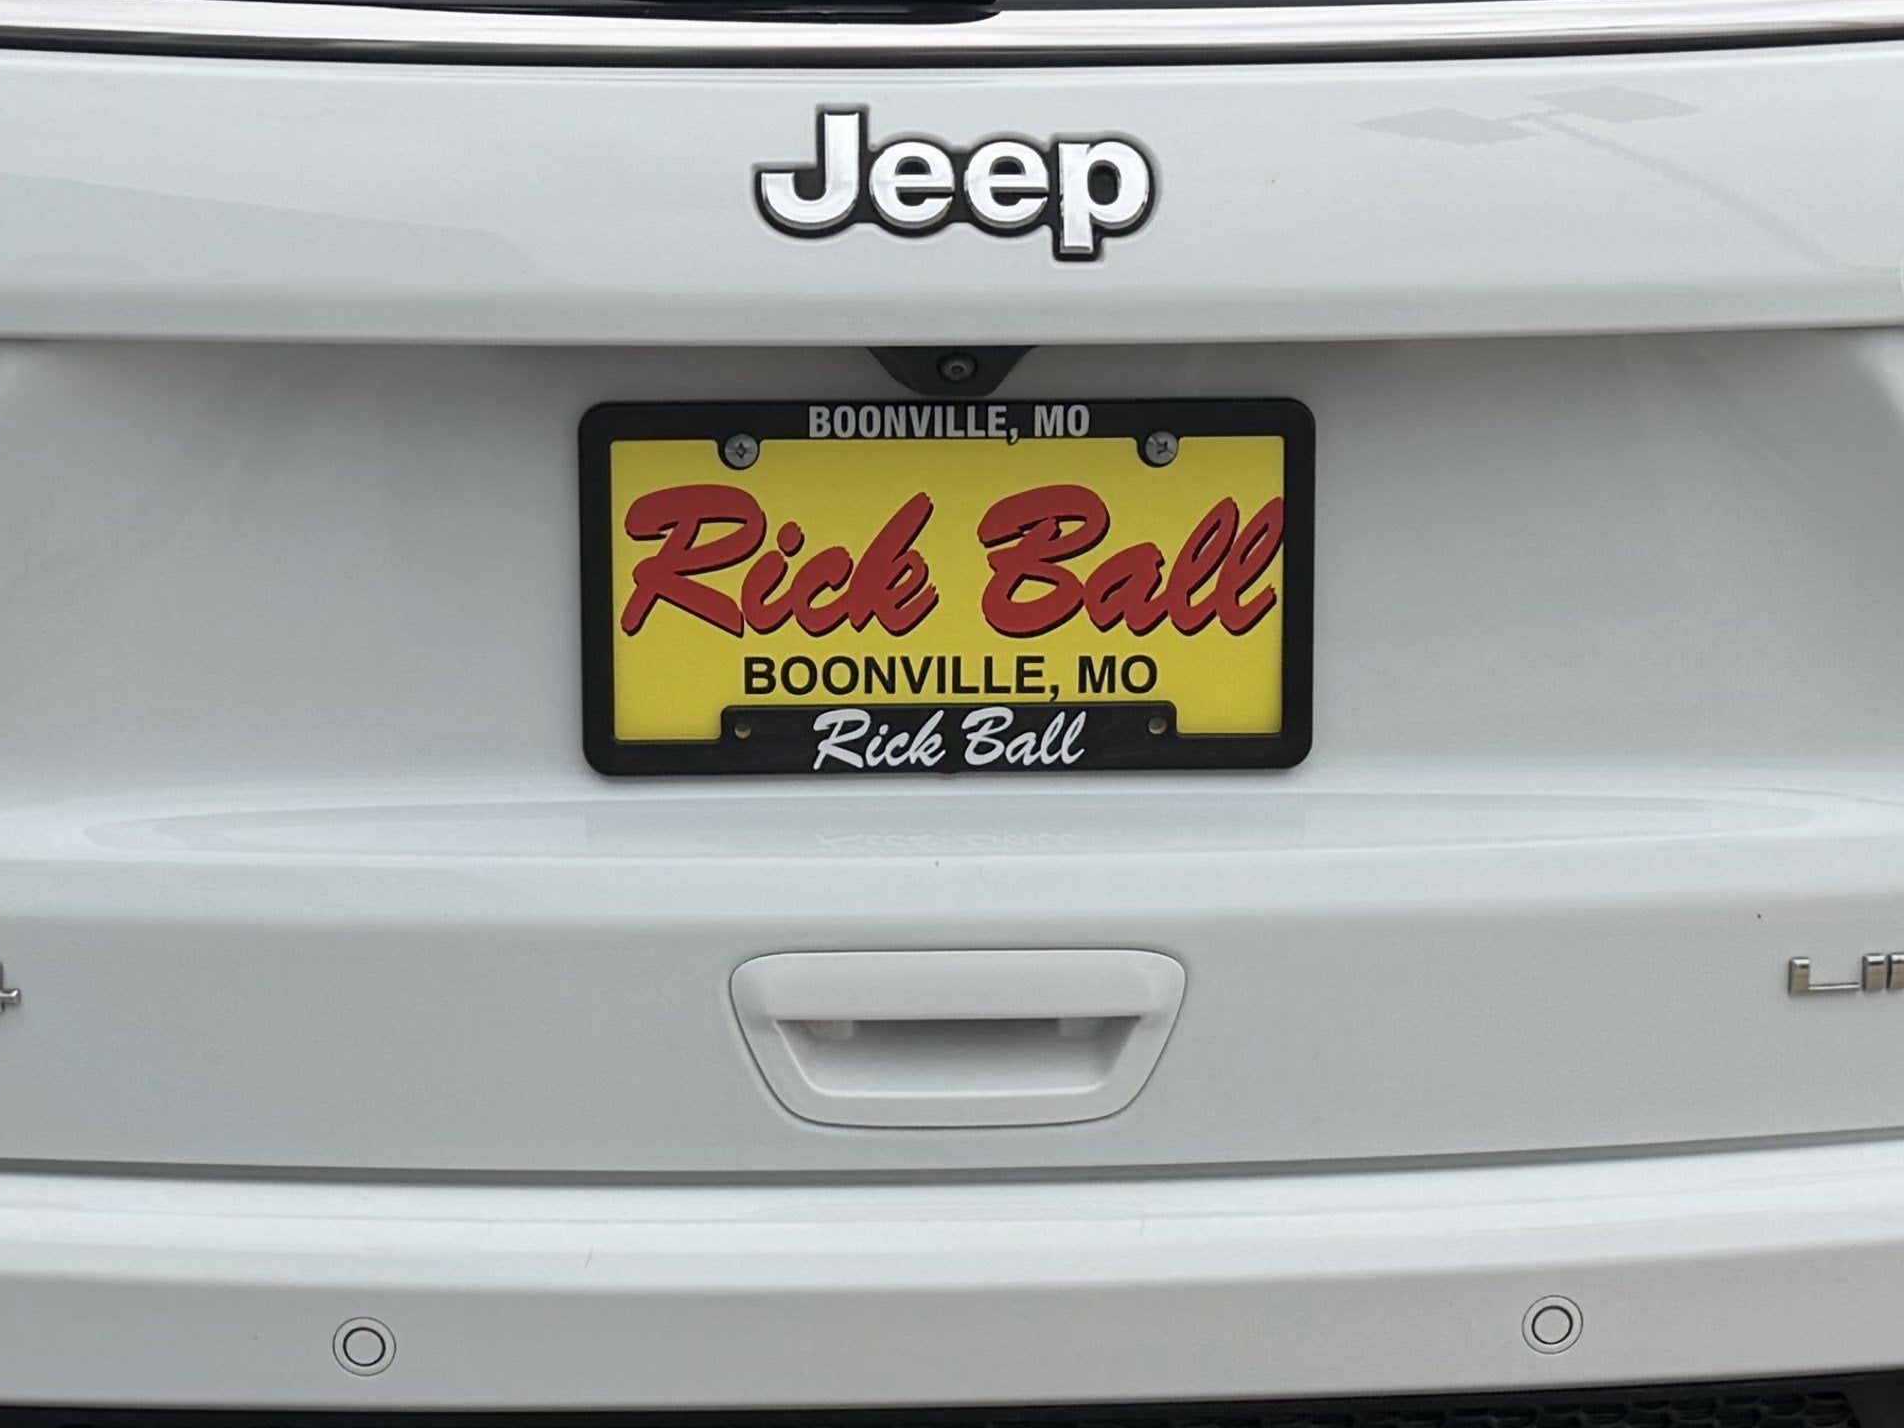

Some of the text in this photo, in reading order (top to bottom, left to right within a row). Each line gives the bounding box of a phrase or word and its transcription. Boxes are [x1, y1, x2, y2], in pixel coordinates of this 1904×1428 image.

[758, 108, 1155, 259] Jeep
[807, 404, 1091, 444] BOONVILLE, MO
[620, 483, 1285, 638] Rick Ball
[743, 654, 1160, 703] BOONVILLE, MO
[812, 708, 1089, 771] Rick Ball
